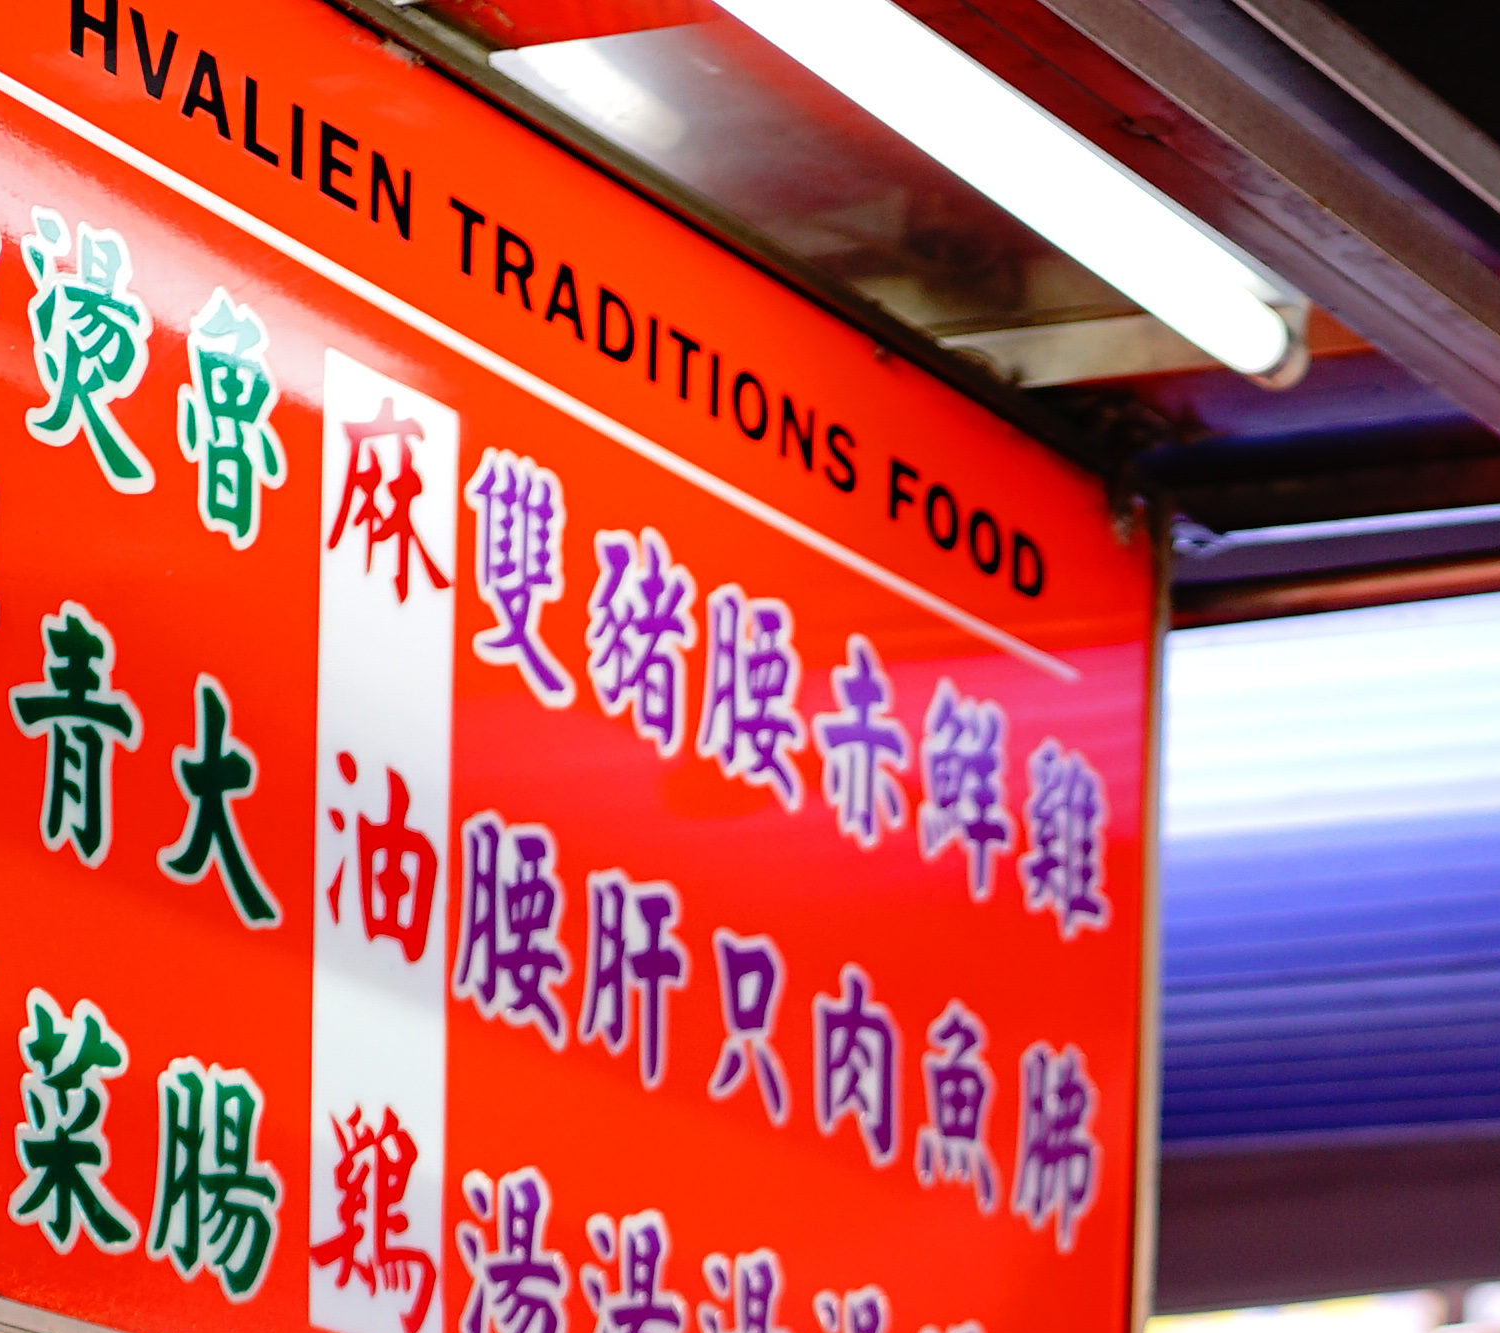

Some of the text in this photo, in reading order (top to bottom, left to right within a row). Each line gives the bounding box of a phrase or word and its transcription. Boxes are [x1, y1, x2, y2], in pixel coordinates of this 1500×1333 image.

[9, 205, 155, 1255] 燙青菜
[70, 0, 1048, 600] HVALIEN TRADITIONS FOOD
[146, 285, 290, 1300] 魯大腸
